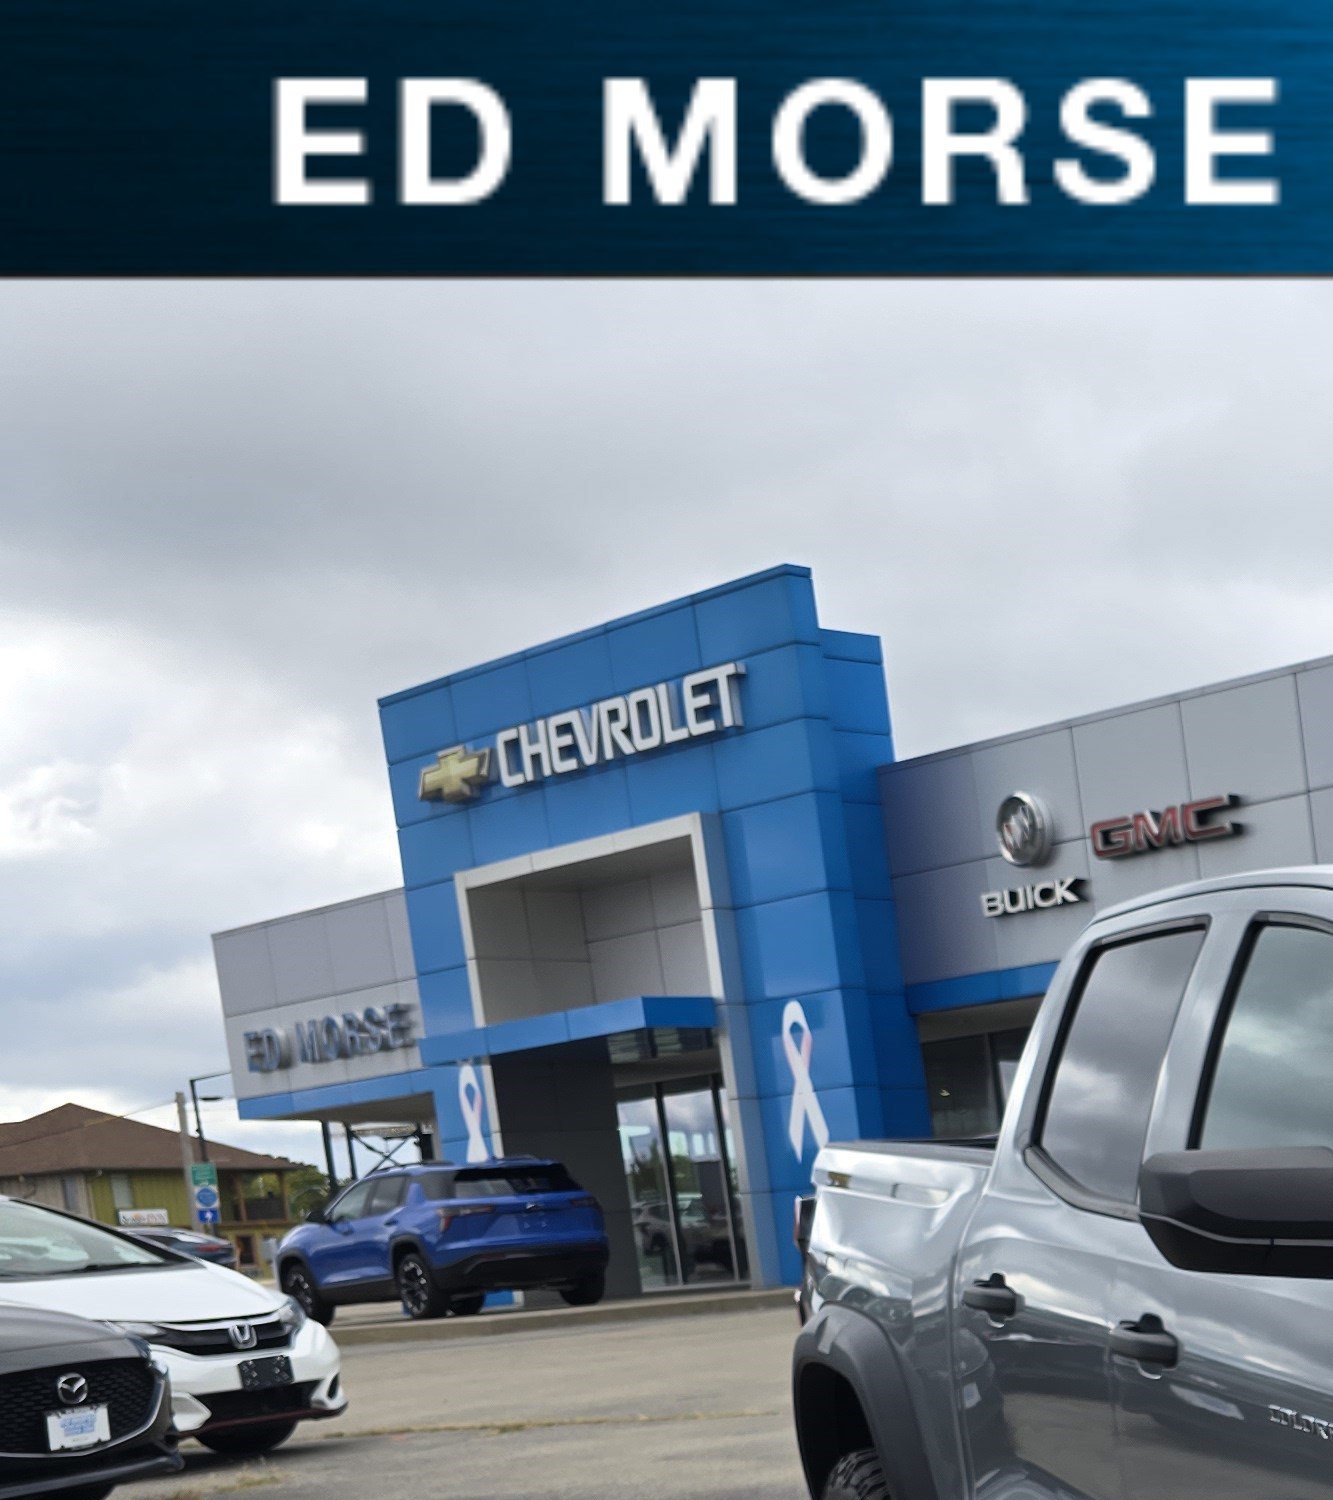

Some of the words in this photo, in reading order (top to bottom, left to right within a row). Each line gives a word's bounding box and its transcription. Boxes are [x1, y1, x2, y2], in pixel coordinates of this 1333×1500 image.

[496, 661, 742, 787] CHEVROLET
[1090, 795, 1233, 859] GMC
[981, 876, 1082, 917] BUICK
[243, 1027, 287, 1073] ED
[295, 1003, 416, 1063] MORSE
